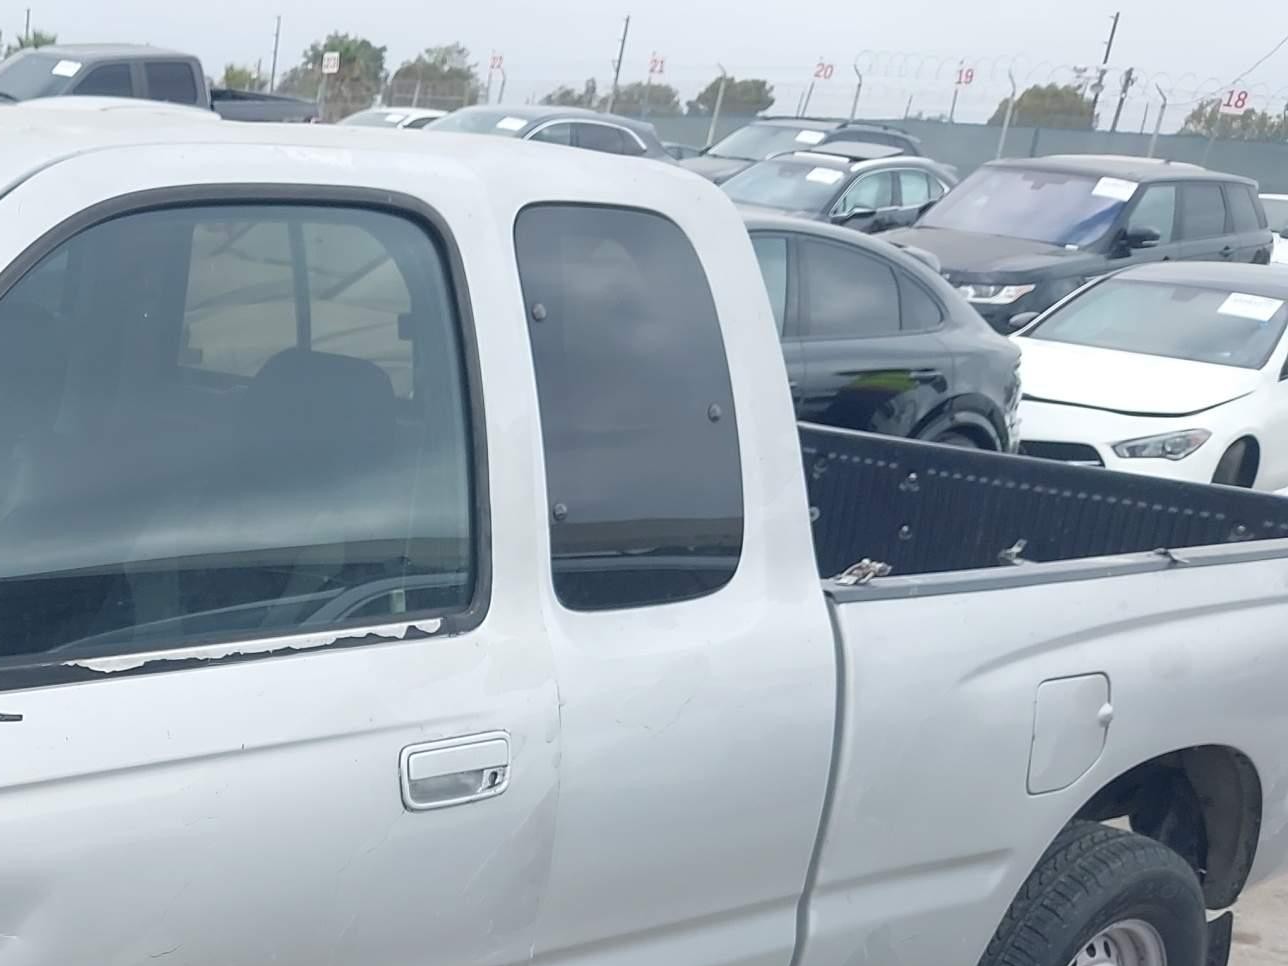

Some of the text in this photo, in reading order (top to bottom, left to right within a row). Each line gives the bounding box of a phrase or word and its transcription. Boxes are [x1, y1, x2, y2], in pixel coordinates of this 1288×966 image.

[649, 57, 665, 74] 21
[814, 62, 834, 80] 20
[955, 67, 974, 85] 19
[1223, 90, 1249, 109] 18
